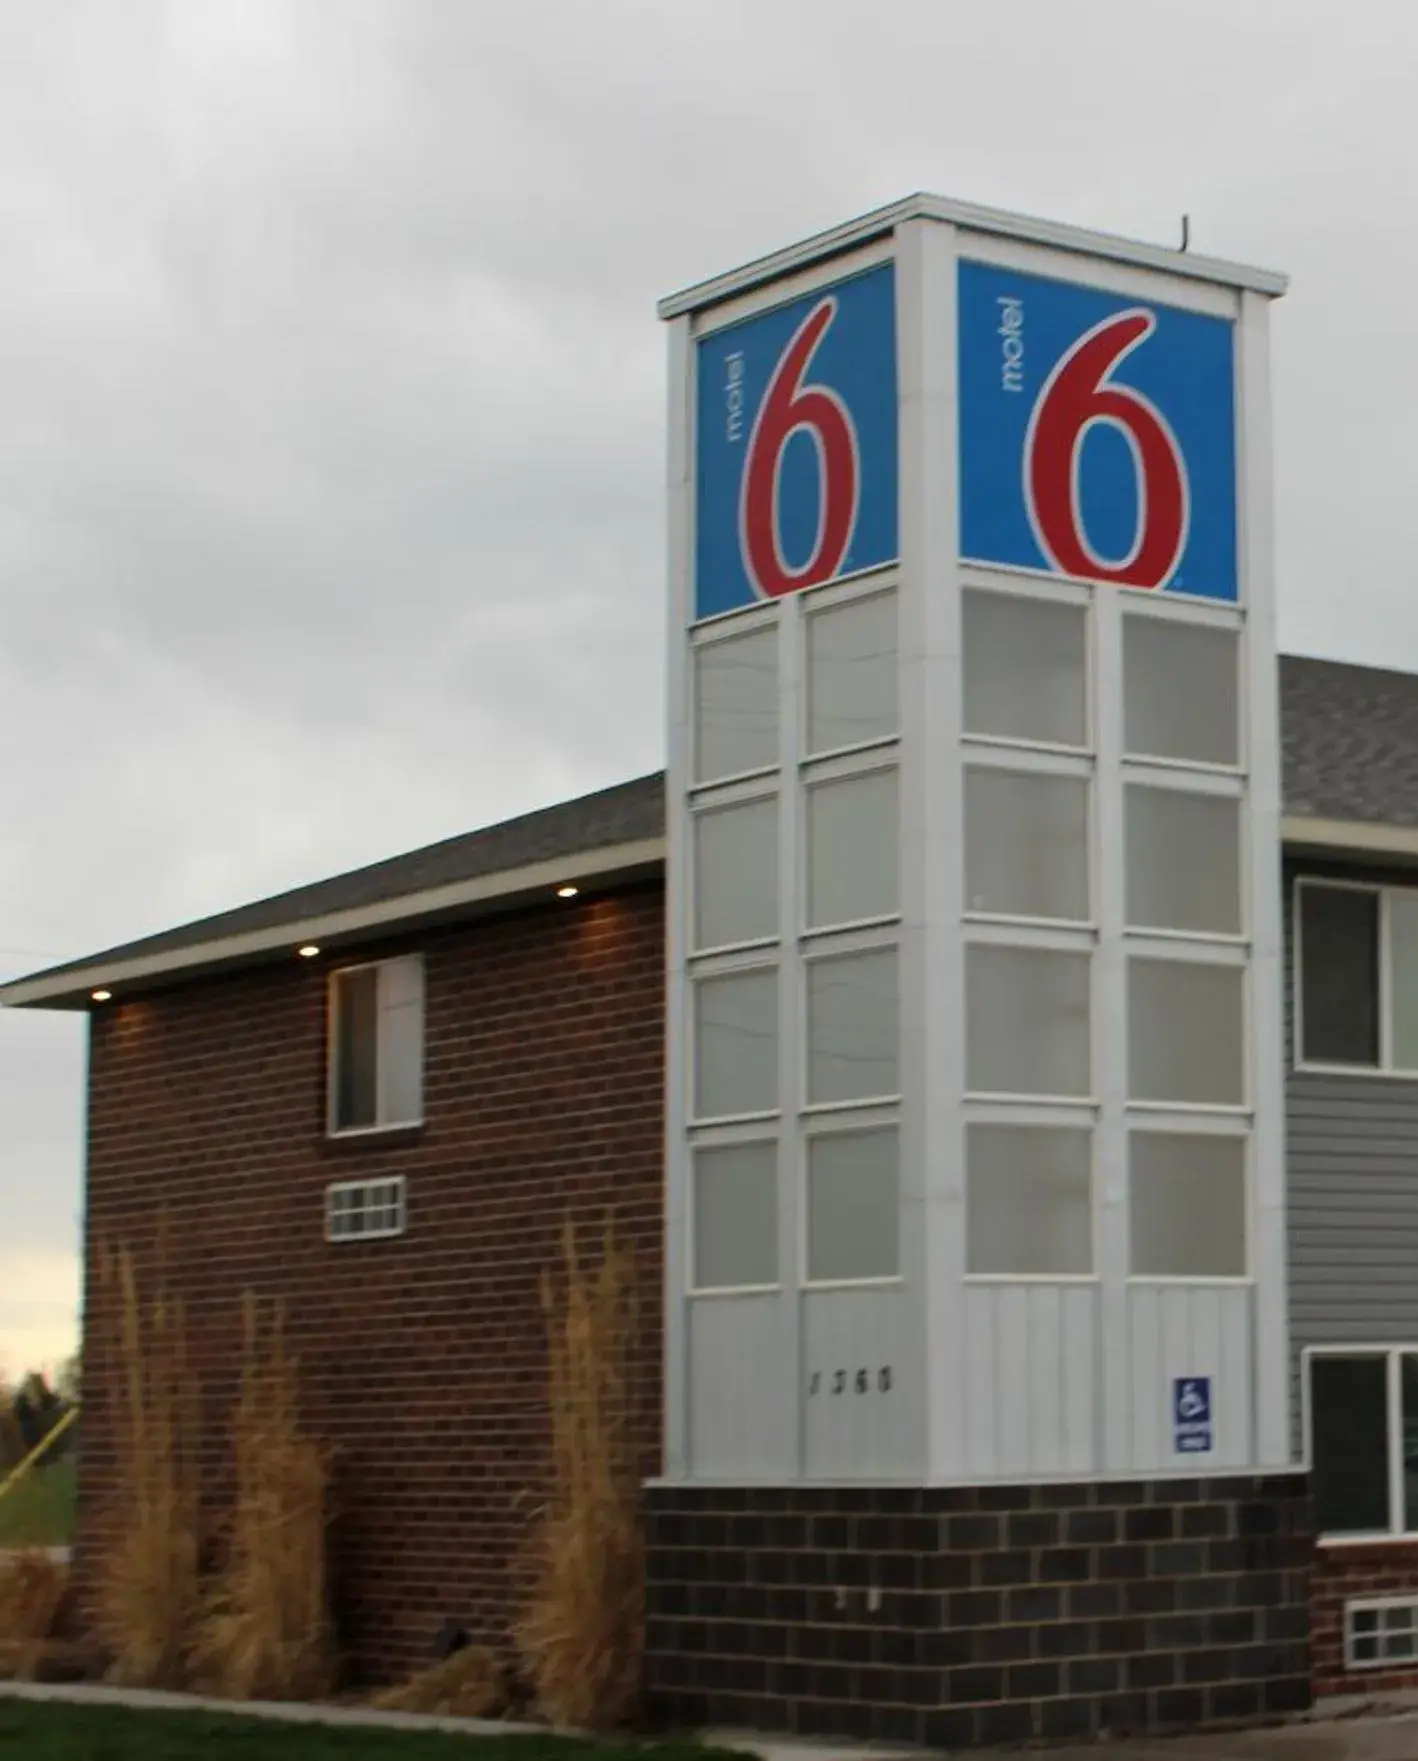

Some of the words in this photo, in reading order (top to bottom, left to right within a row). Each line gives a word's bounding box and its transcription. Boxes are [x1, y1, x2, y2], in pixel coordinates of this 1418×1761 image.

[724, 350, 744, 442] motel
[739, 295, 861, 600] 6
[998, 297, 1024, 392] motel
[1022, 307, 1191, 591] 6
